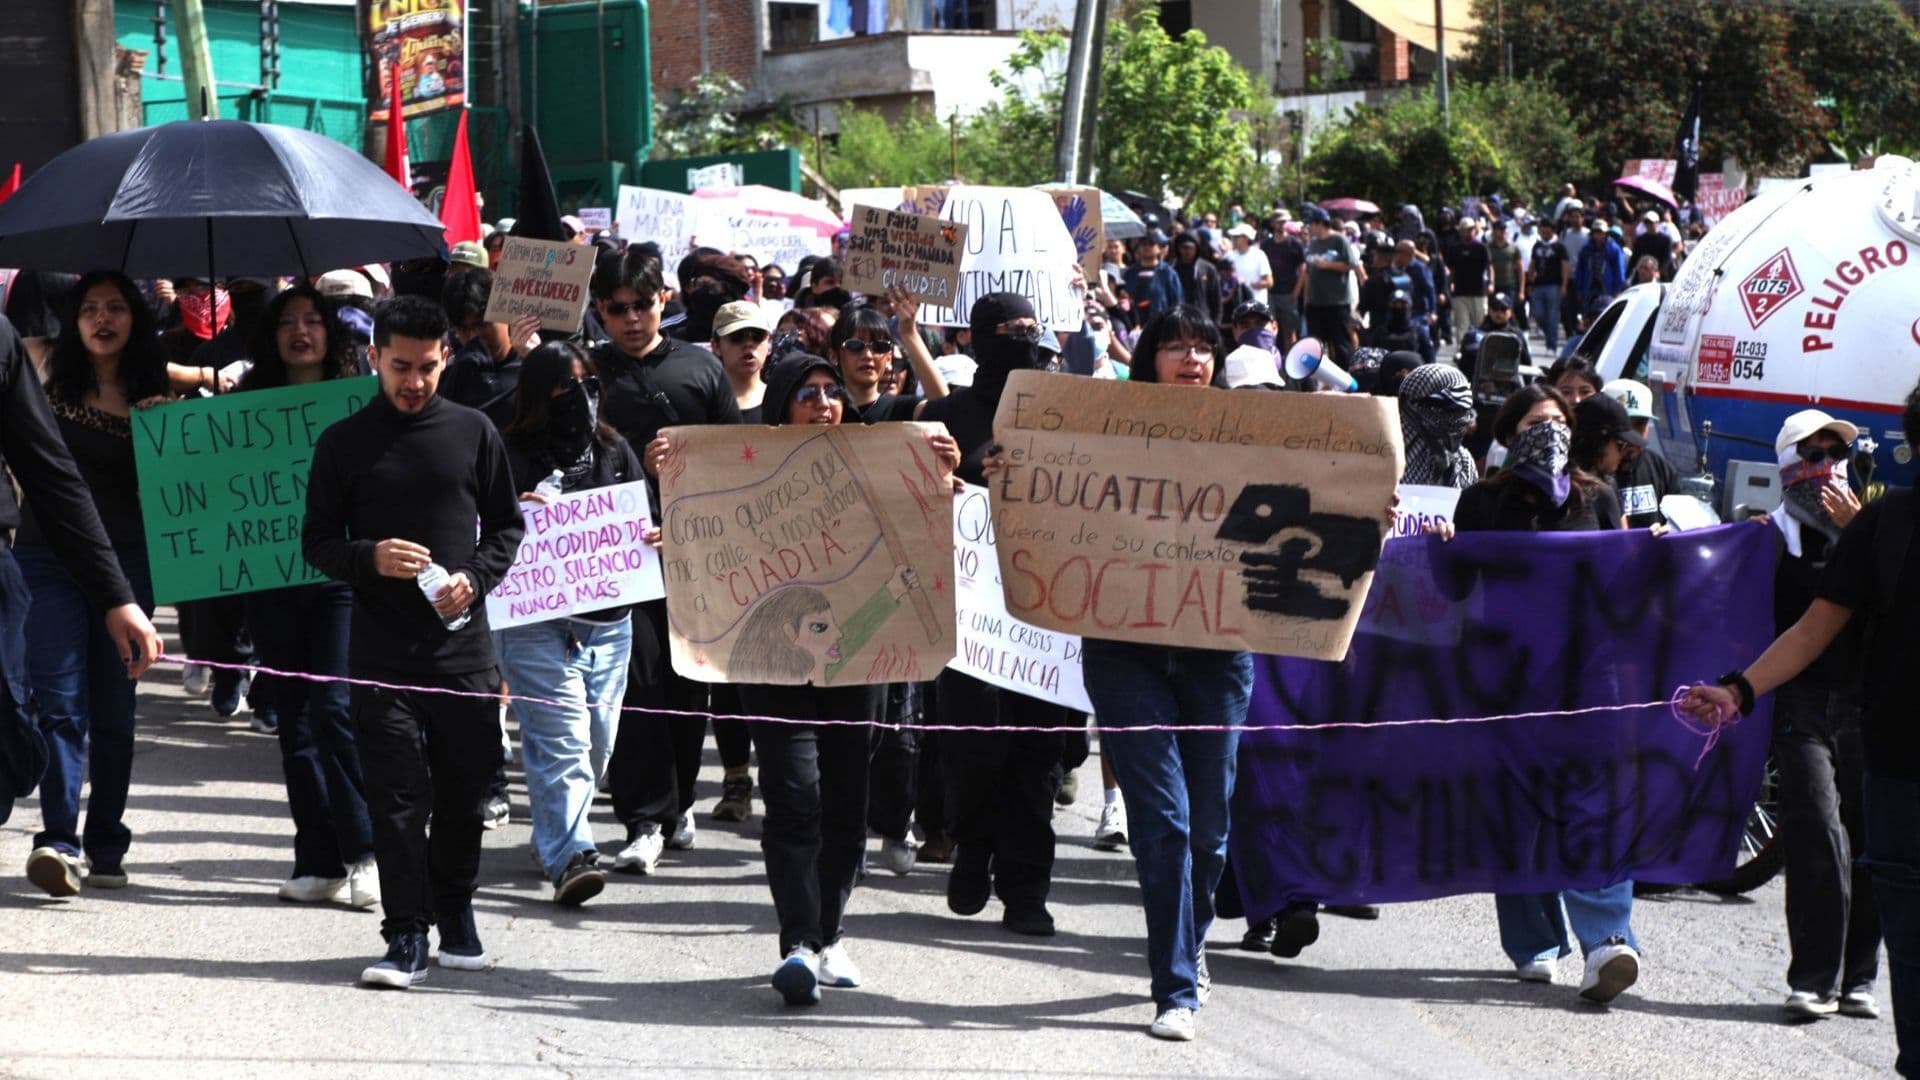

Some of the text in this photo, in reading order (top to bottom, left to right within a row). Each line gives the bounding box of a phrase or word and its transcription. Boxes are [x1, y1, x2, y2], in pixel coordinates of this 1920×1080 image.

[998, 199, 1017, 255] A
[1750, 279, 1789, 295] 1075
[1755, 297, 1768, 313] 2
[1802, 239, 1908, 353] PELIGRO
[1733, 359, 1764, 380] 054
[1735, 341, 1768, 356] AT-033
[1014, 391, 1065, 432] Es
[1101, 409, 1255, 449] imposible
[1626, 389, 1639, 408] LA
[139, 401, 317, 457] VENISTE
[1010, 437, 1092, 467] el acto
[160, 459, 311, 518] UN SUEÑ
[735, 471, 809, 537] quieres
[999, 464, 1225, 524] EDUCATIVO
[160, 514, 299, 559] TE ARREB
[624, 517, 648, 544] DE
[1070, 522, 1099, 546] de
[218, 557, 254, 592] LA
[563, 548, 643, 585] SILENCIO
[509, 576, 621, 619] NUNCA MÁS
[694, 592, 707, 613] a
[1006, 548, 1243, 637] SOCIAL
[971, 611, 1002, 639] UNA
[1008, 622, 1055, 654] CRISIS
[963, 635, 1061, 696] VIOLENCIA
